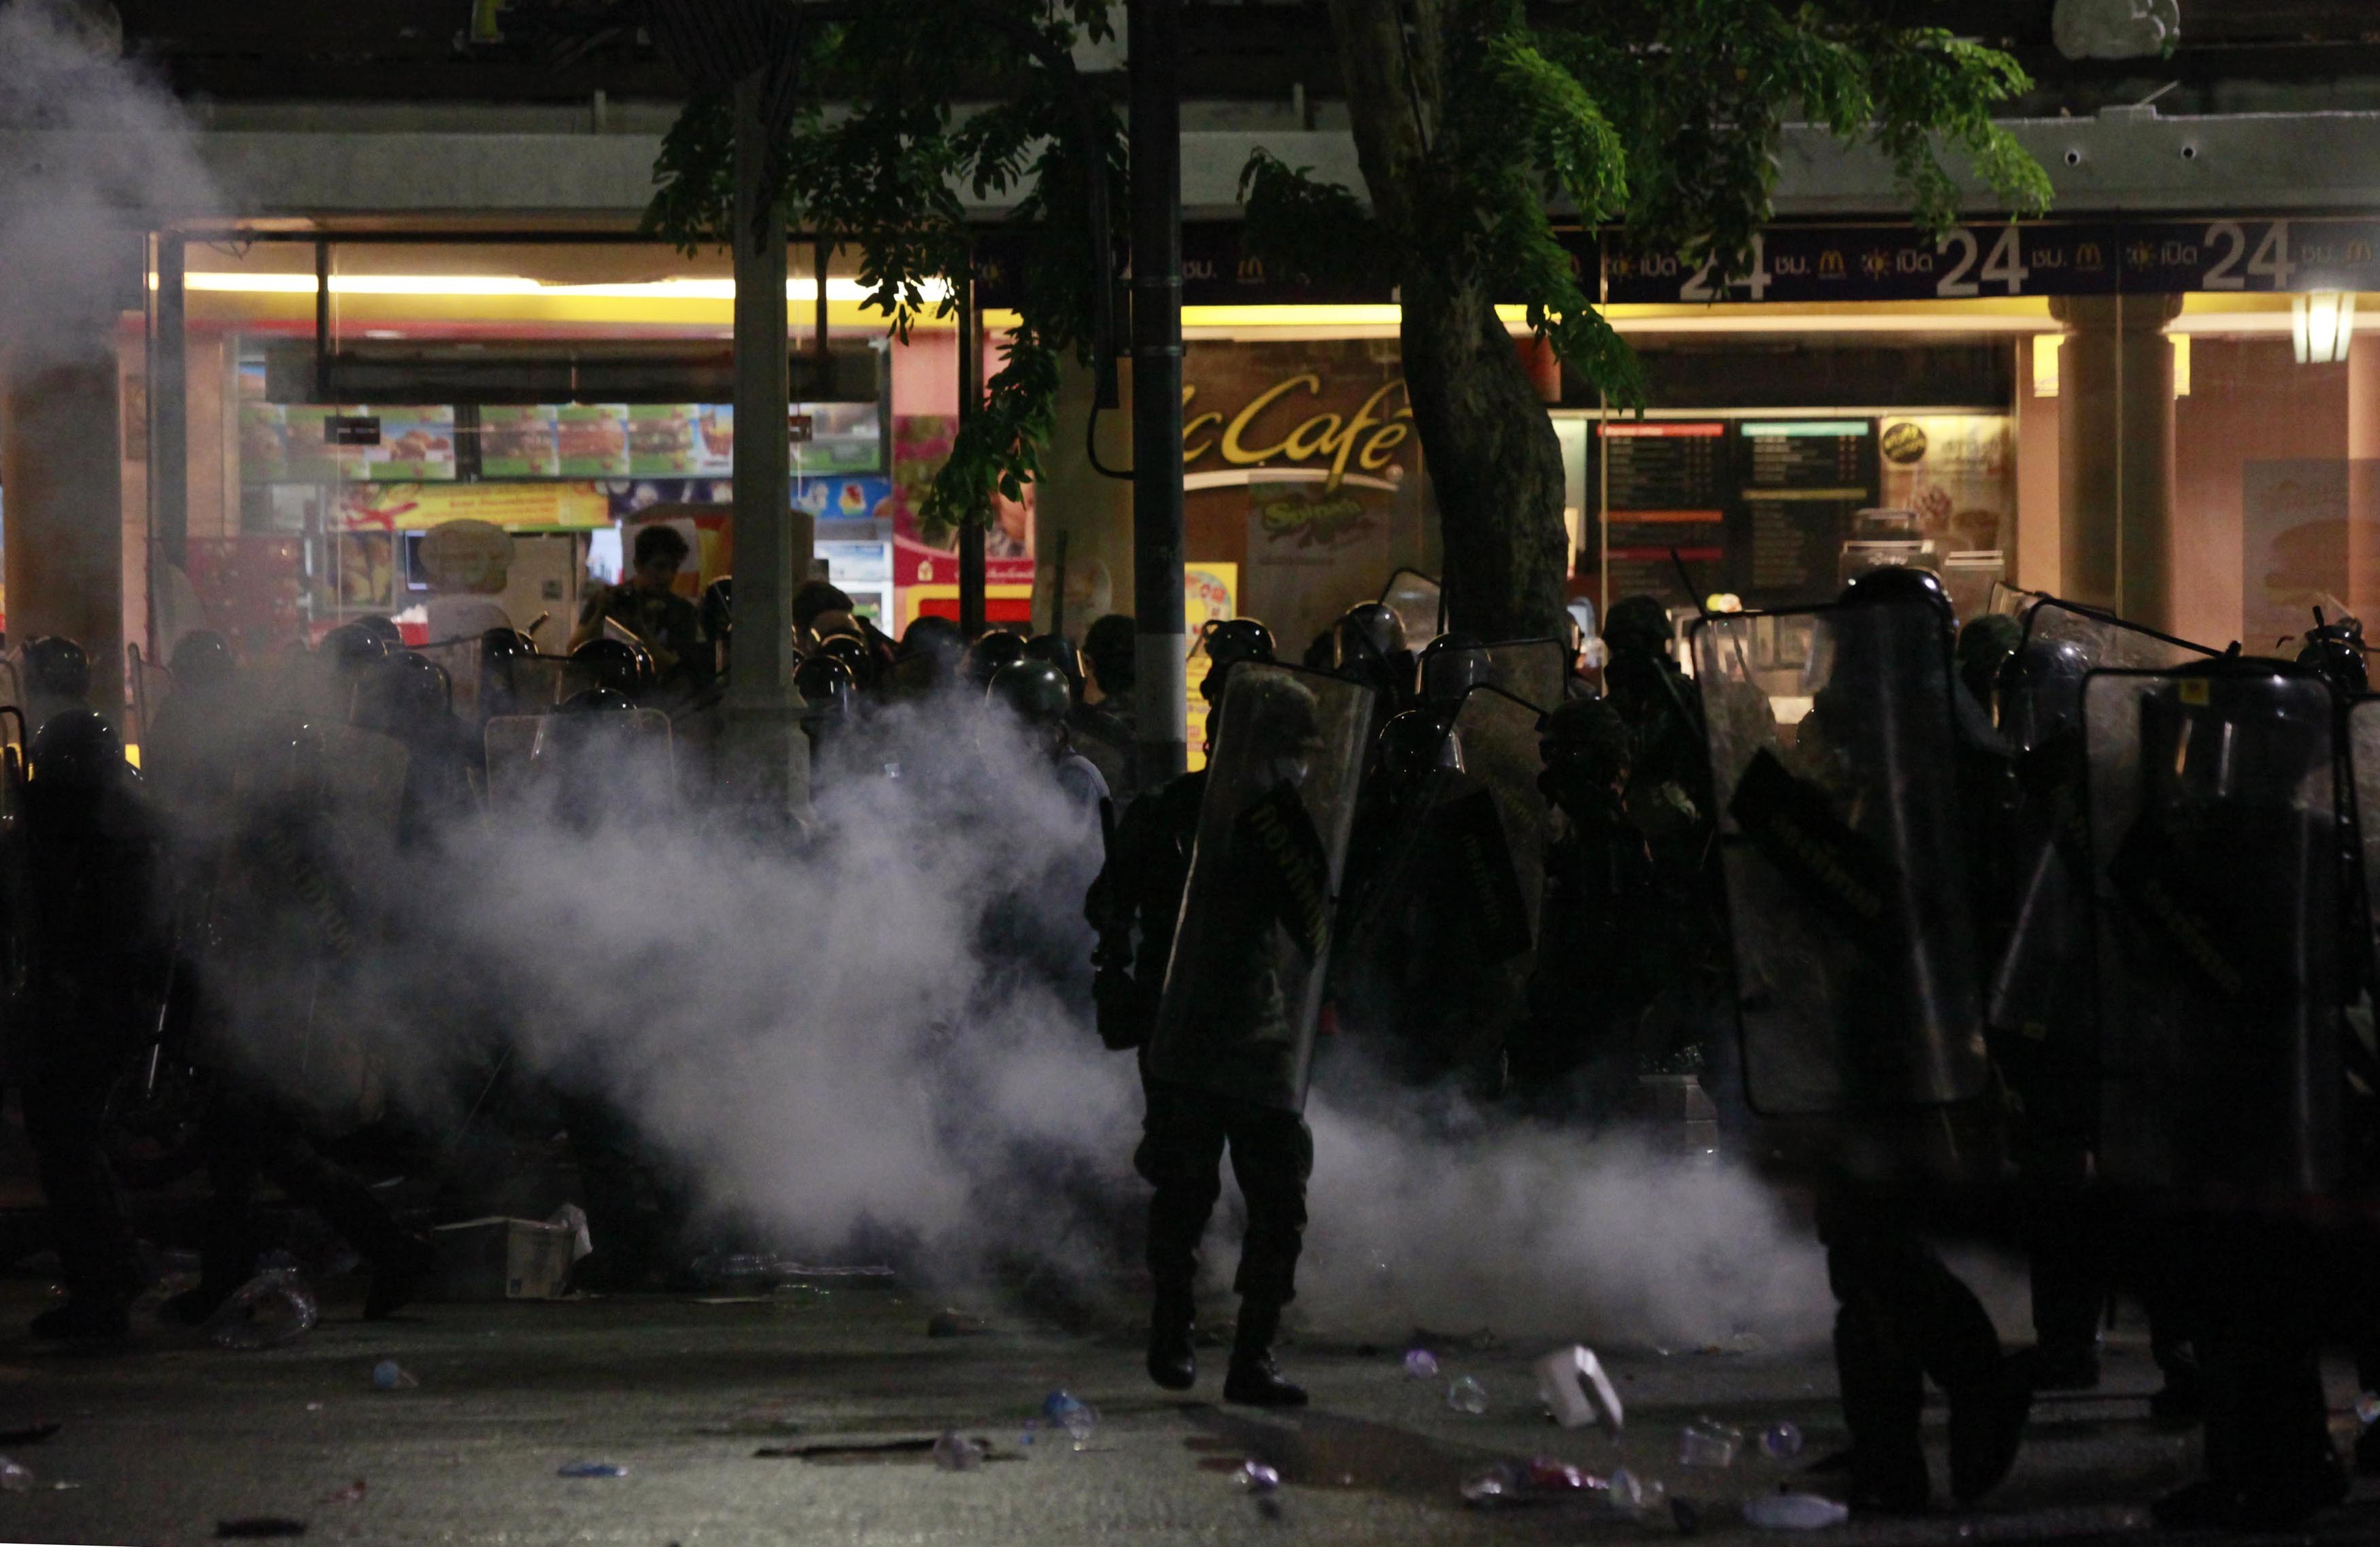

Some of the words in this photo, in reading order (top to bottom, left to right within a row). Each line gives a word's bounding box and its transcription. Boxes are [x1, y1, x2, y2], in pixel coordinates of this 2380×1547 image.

[1680, 233, 1772, 301] 24
[1937, 228, 2030, 296] 24
[2203, 219, 2296, 290] 24
[1183, 373, 1413, 494] cCafé
